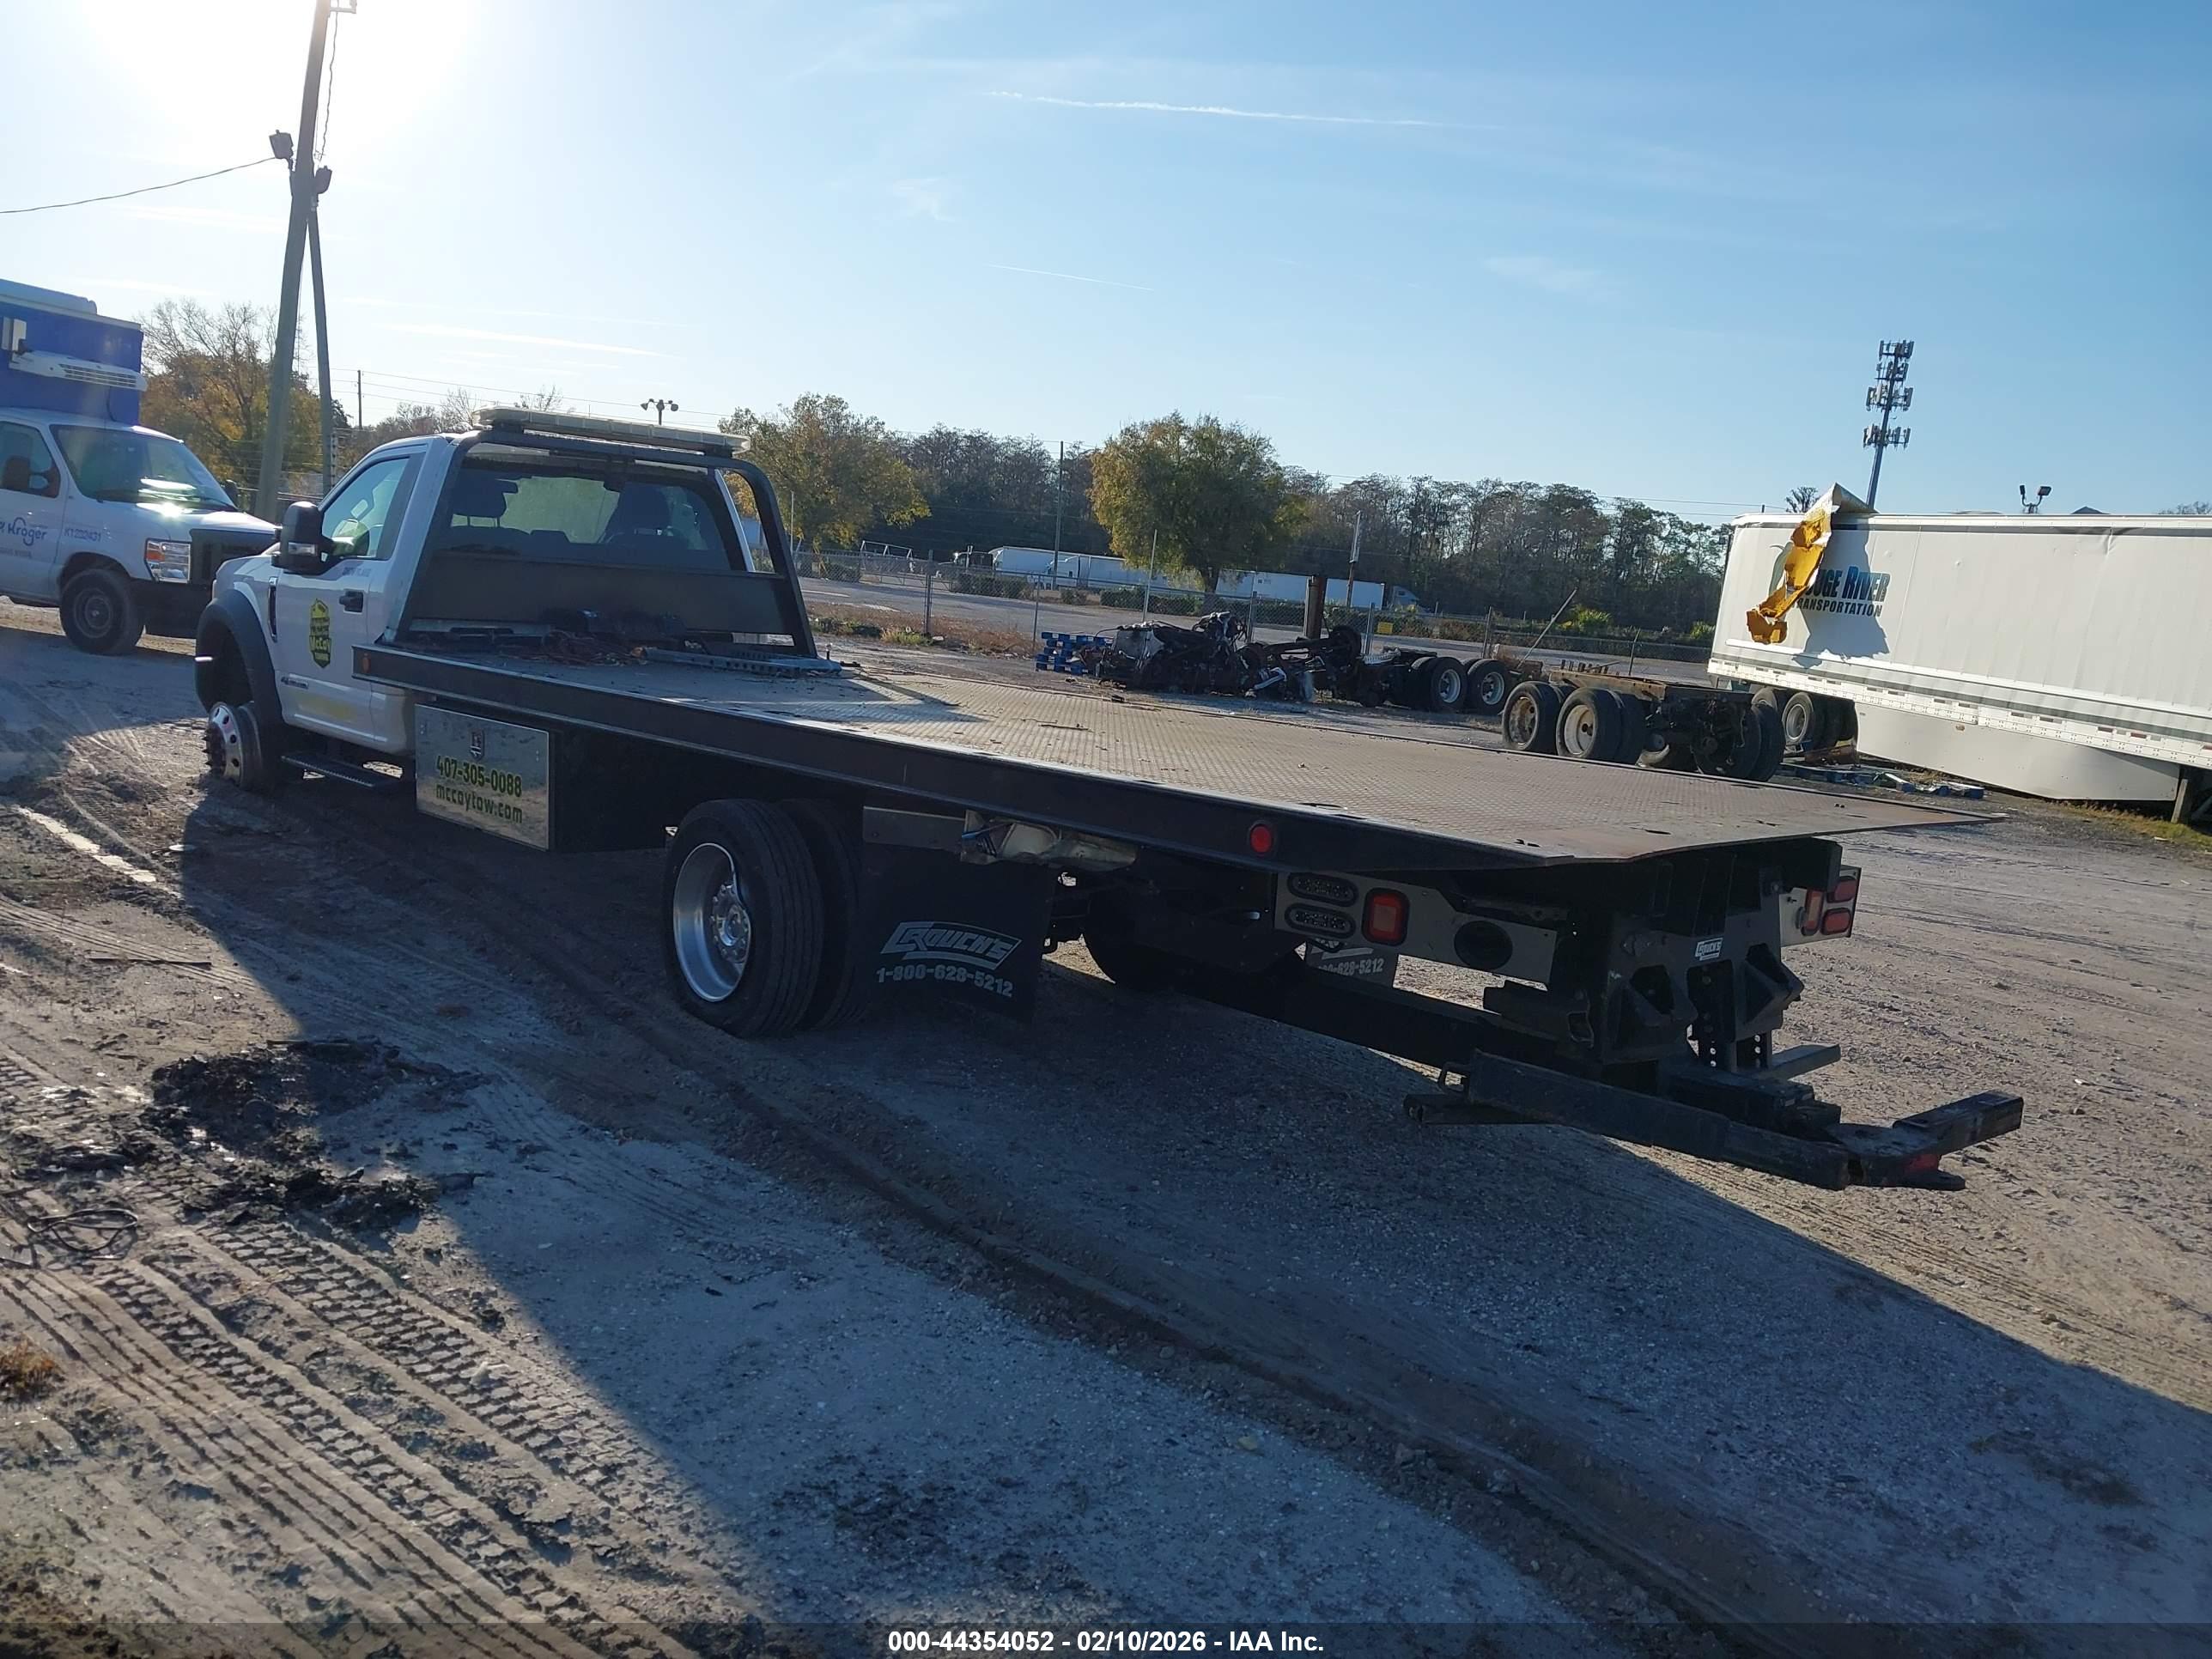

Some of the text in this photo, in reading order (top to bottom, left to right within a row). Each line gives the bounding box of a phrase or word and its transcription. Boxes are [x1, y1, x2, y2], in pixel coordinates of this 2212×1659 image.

[8, 517, 47, 545] Kroger
[1841, 566, 1891, 603] RIVER
[1793, 598, 1883, 617] RANSPORTATION
[435, 755, 522, 798] 407-305-0088
[435, 783, 523, 824] mccoytow.com
[880, 921, 1017, 962] CROUCH'S
[876, 963, 1013, 998] 1-800-628-5212
